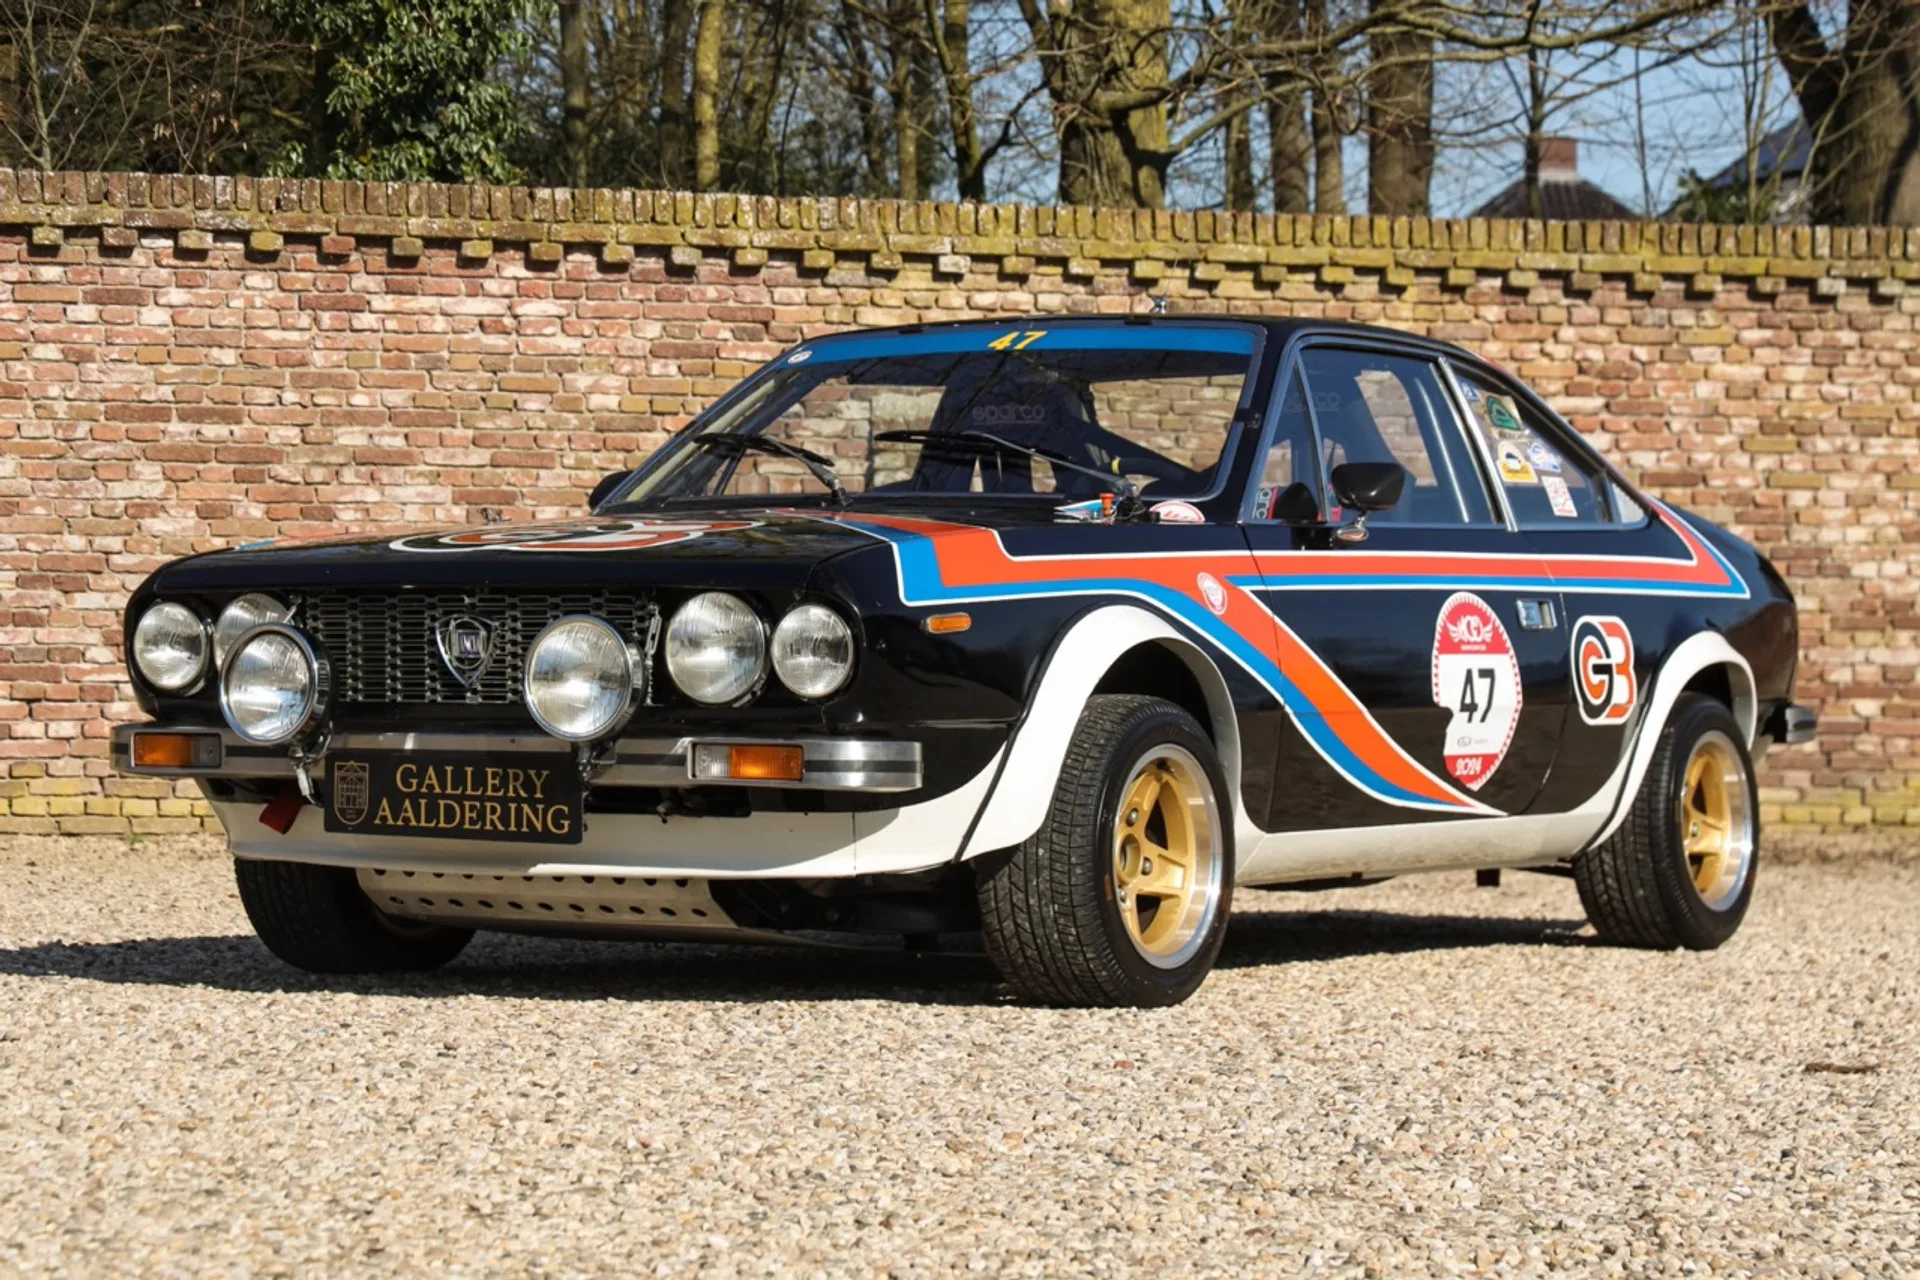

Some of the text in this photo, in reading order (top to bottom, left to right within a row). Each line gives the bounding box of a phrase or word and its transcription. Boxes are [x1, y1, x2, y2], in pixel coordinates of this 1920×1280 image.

[988, 330, 1047, 351] 47
[1459, 668, 1496, 723] 47
[395, 763, 550, 798] GALLERY
[1454, 756, 1483, 776] 2024
[374, 796, 571, 834] AALDERING
